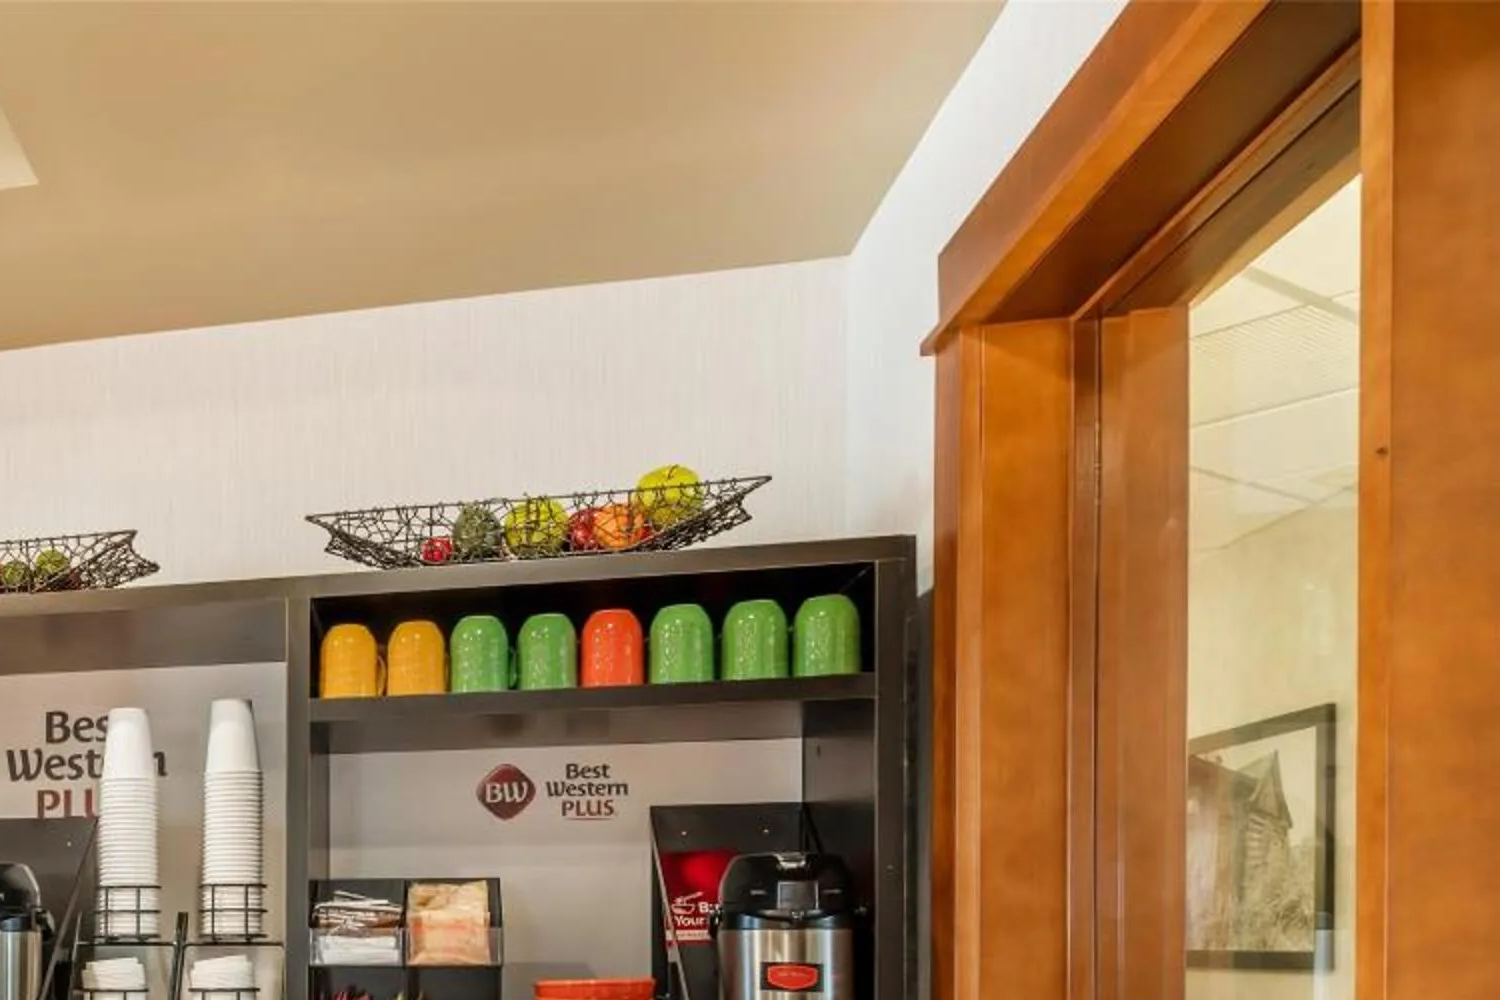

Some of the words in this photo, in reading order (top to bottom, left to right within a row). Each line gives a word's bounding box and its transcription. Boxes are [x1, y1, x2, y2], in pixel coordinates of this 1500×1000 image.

[45, 711, 108, 744] Bes
[6, 748, 168, 782] Westn
[565, 763, 611, 780] Best
[485, 782, 528, 803] BW
[545, 780, 629, 797] Western
[561, 799, 615, 817] PLUS
[674, 915, 705, 927] Your
